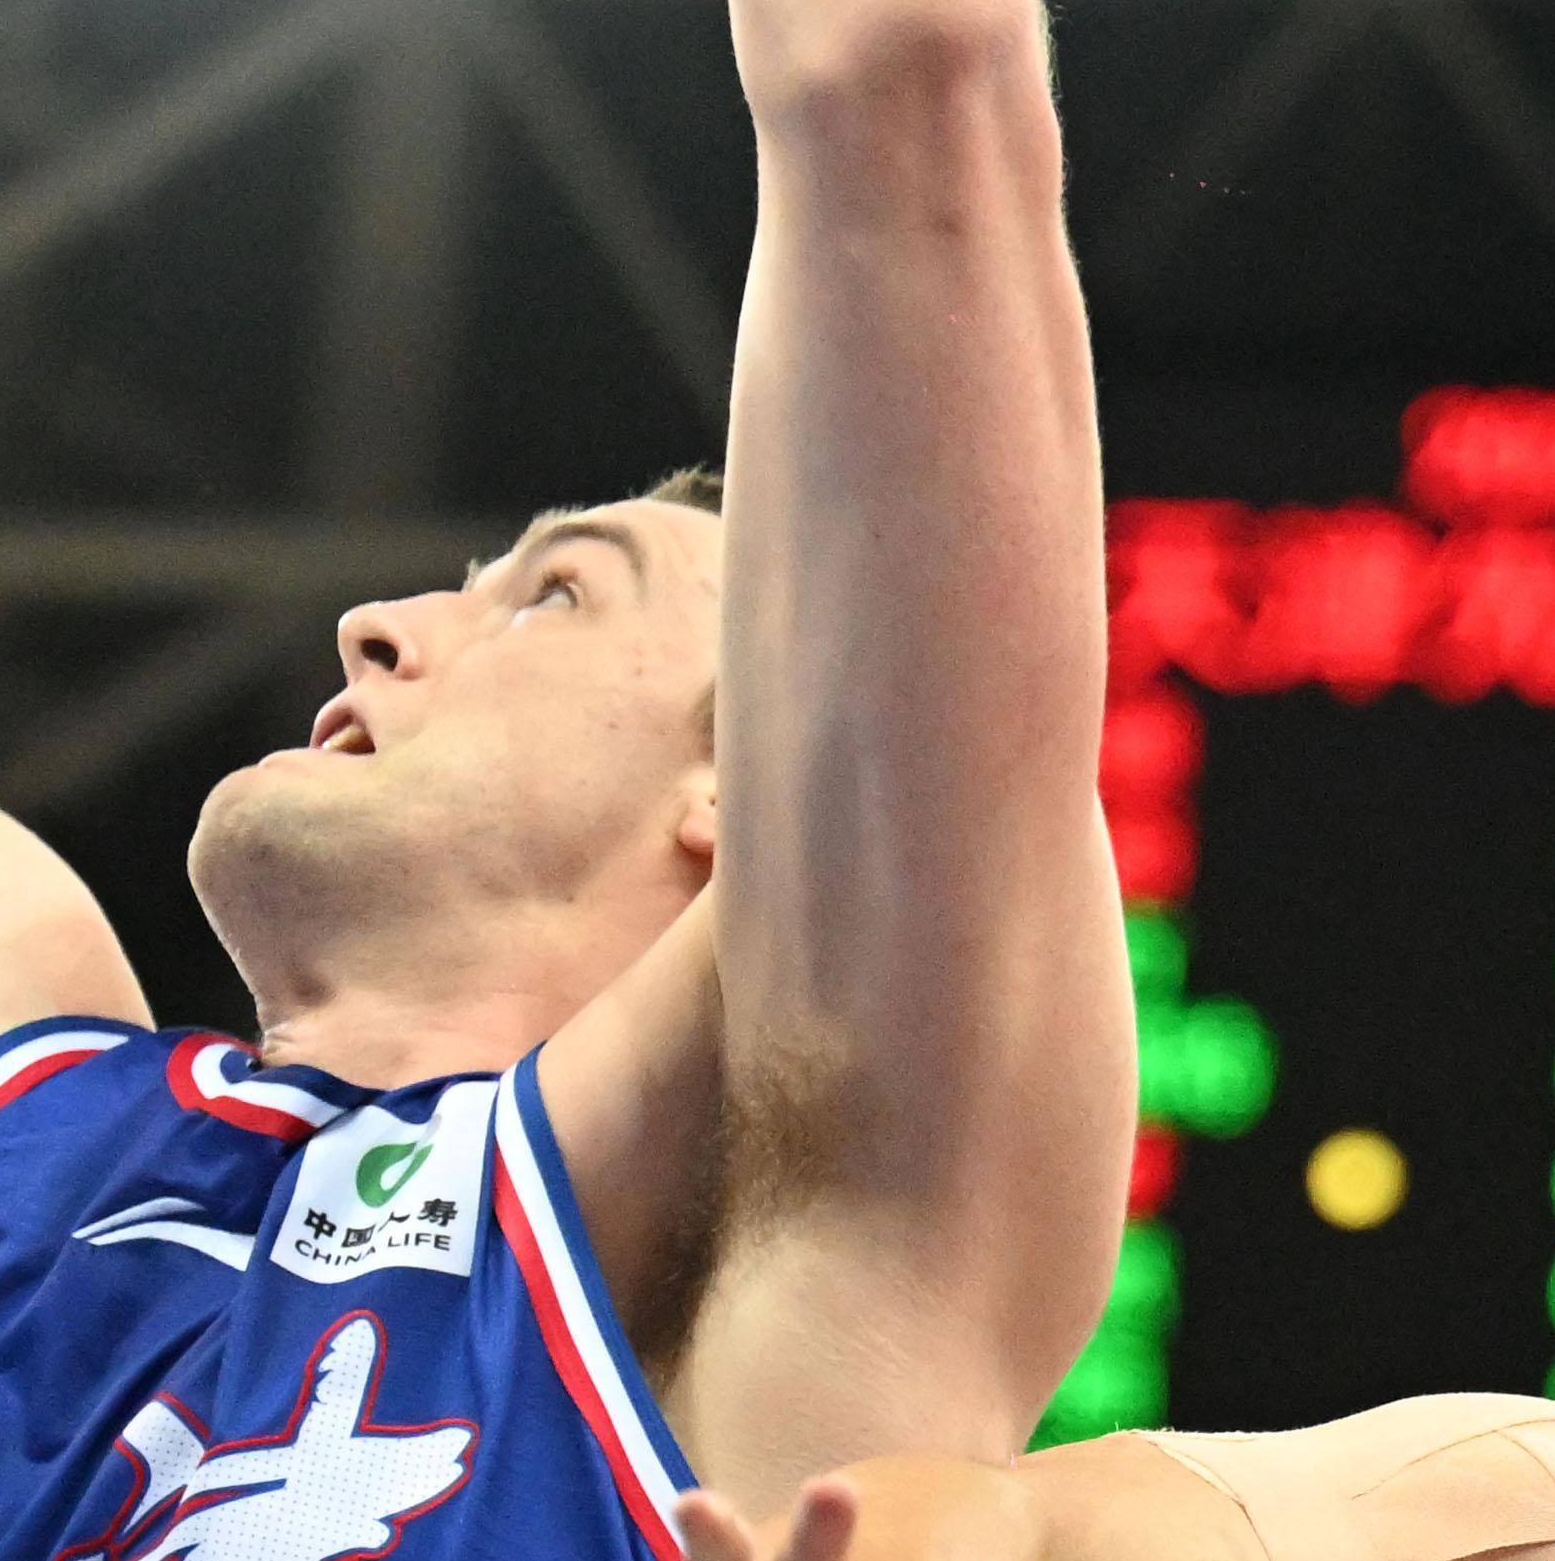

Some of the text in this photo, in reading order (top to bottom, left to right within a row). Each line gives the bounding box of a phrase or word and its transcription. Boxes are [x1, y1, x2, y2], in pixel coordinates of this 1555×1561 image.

[304, 1198, 458, 1248] 中国人寿
[295, 1233, 452, 1267] CHINA LIFE
